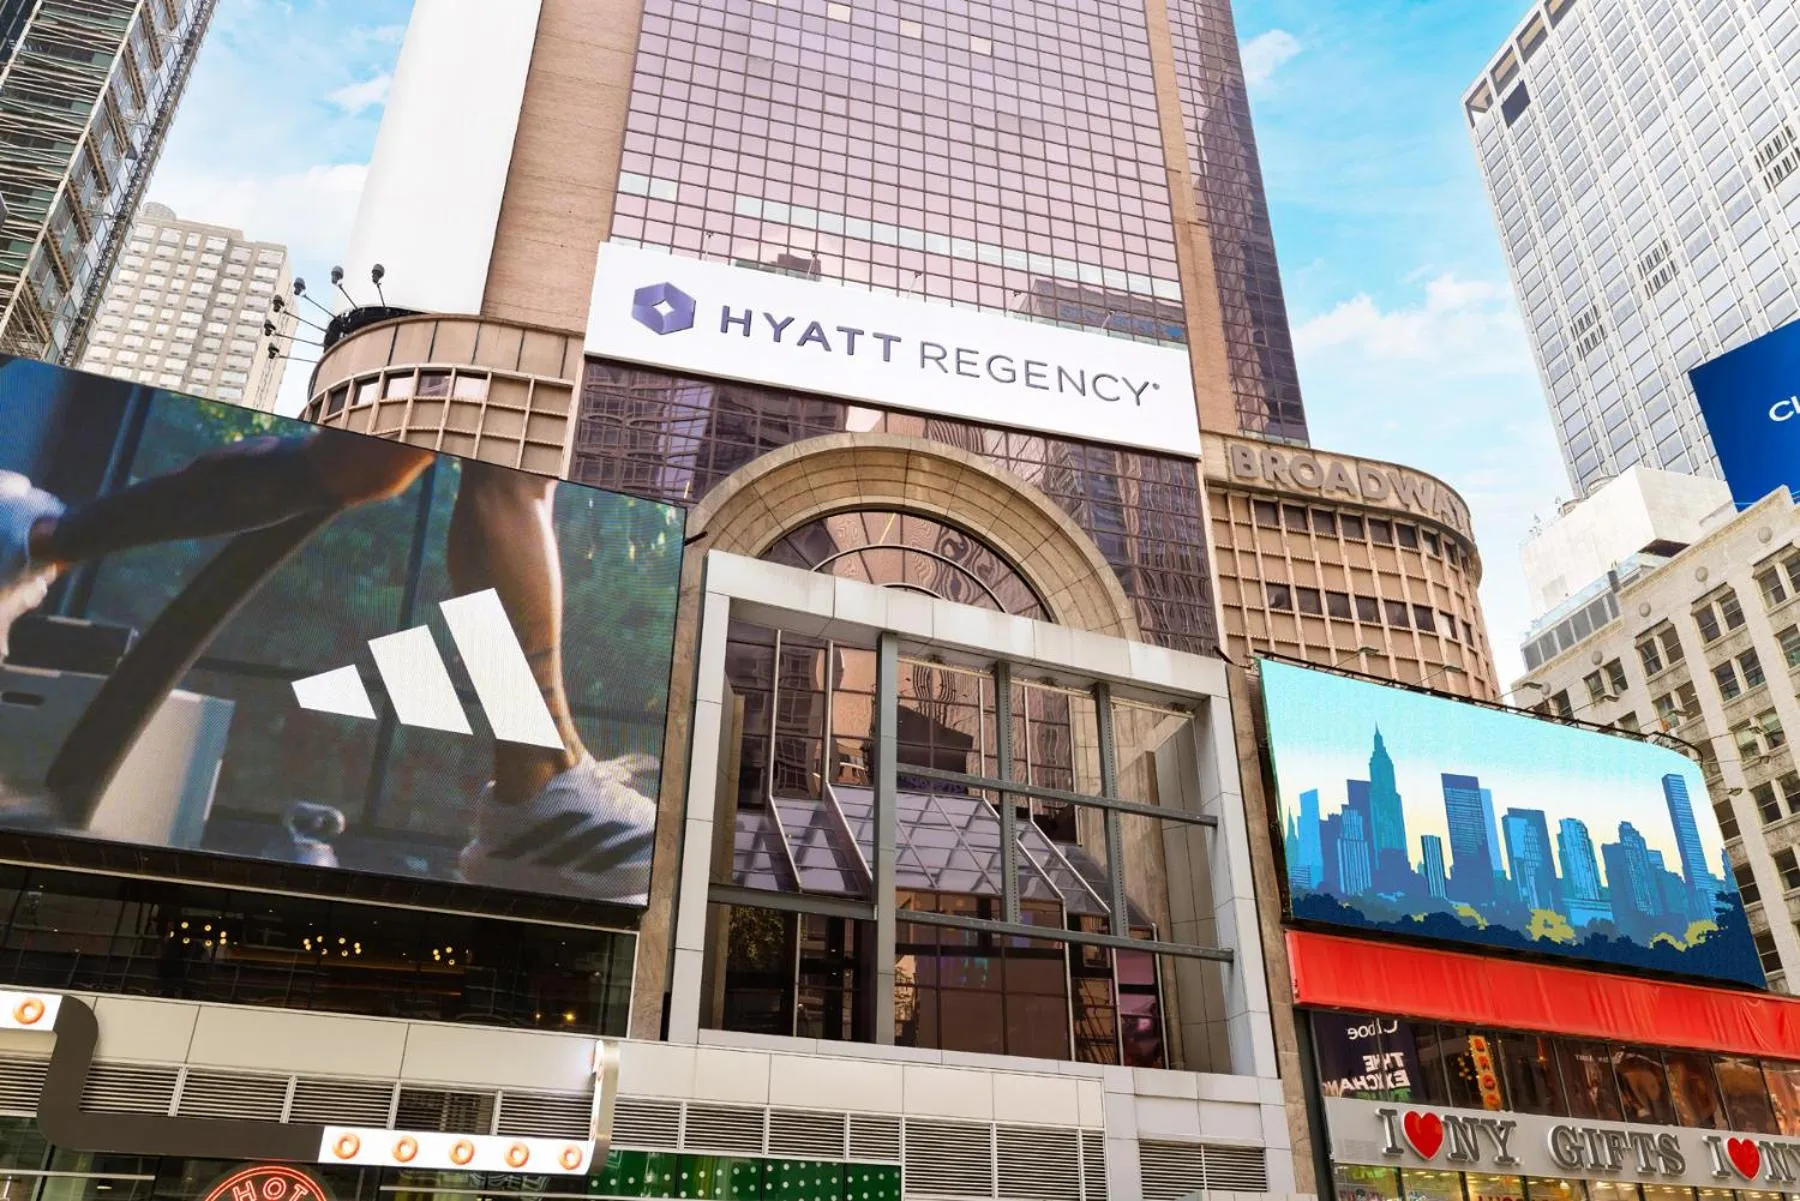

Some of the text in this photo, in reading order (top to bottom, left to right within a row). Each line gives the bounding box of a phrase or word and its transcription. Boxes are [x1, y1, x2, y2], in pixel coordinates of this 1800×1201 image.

[718, 304, 1152, 407] HYATT REGENCY
[1375, 1108, 1404, 1154] I
[1440, 1114, 1519, 1163] NY
[1547, 1124, 1687, 1177] GIFTS
[1702, 1135, 1732, 1179] I
[232, 1176, 310, 1201] HOT
